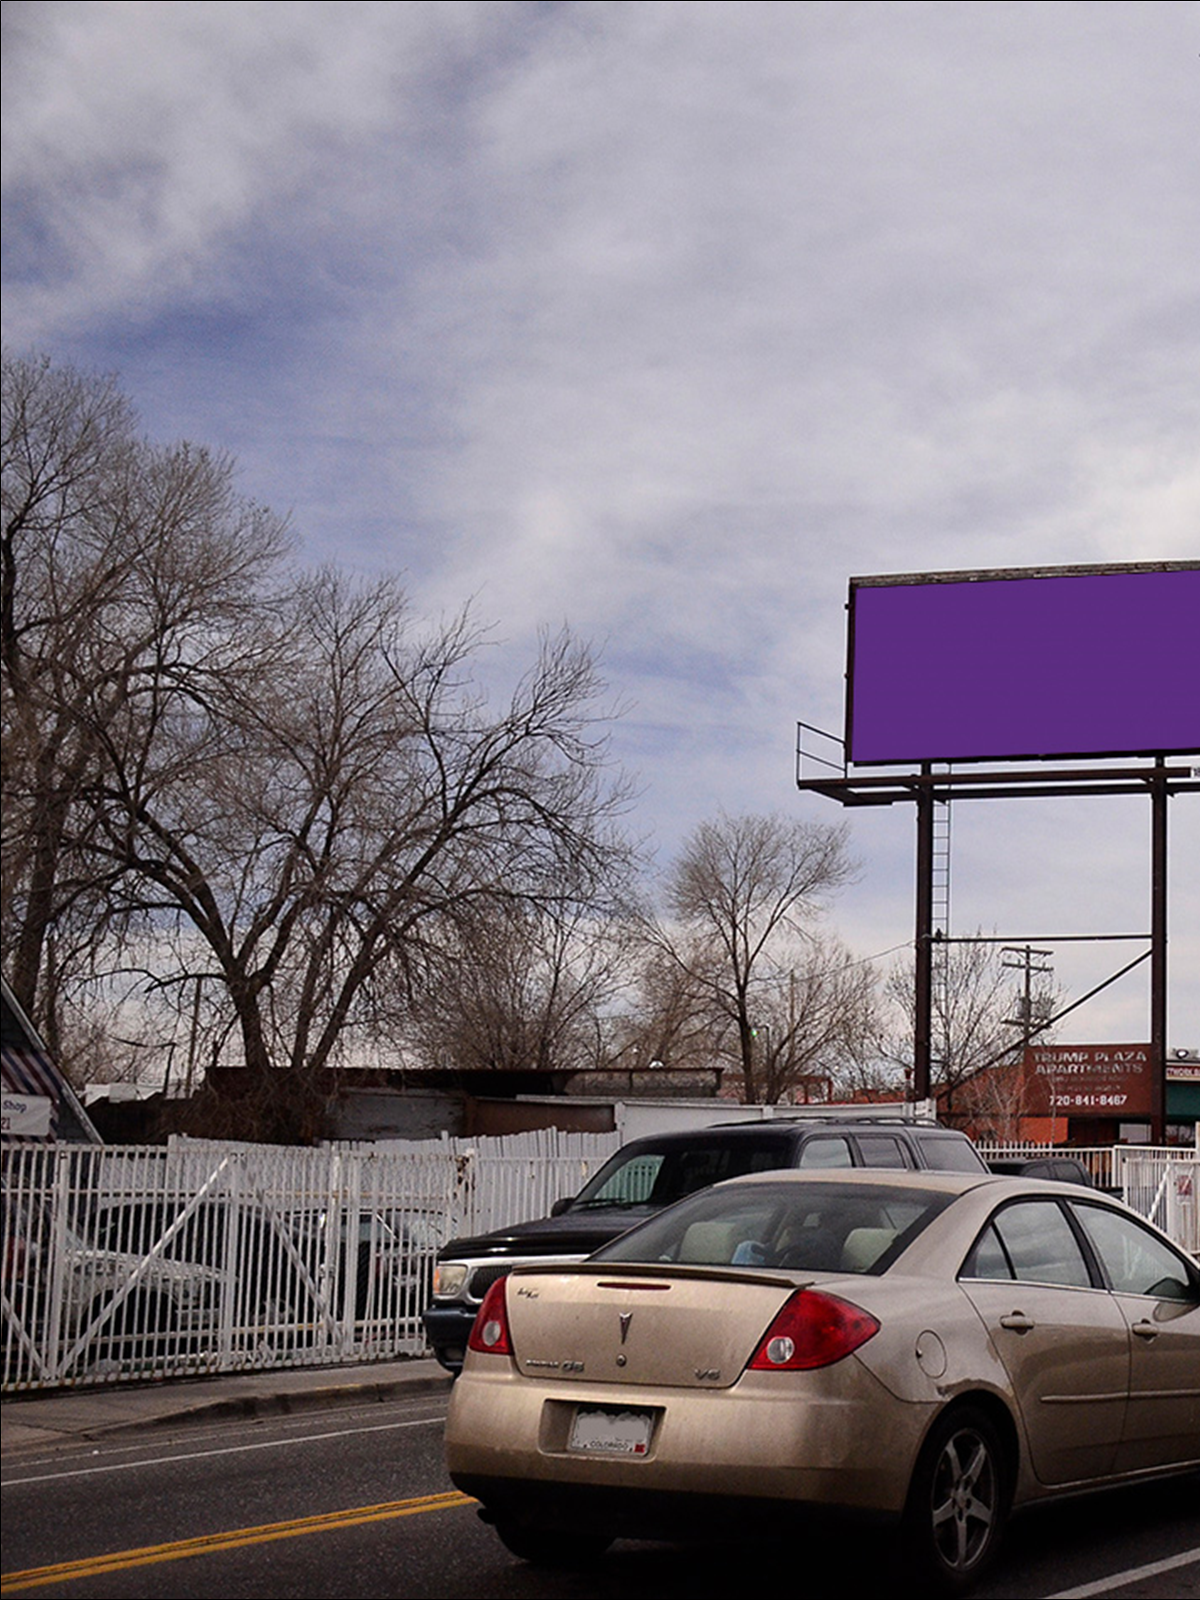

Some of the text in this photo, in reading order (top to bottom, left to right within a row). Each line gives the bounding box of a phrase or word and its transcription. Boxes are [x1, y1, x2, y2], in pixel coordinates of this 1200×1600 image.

[1034, 1051, 1147, 1062] TRUMP PLAZA
[1036, 1063, 1143, 1074] APARTMENTS
[694, 1369, 721, 1381] V6
